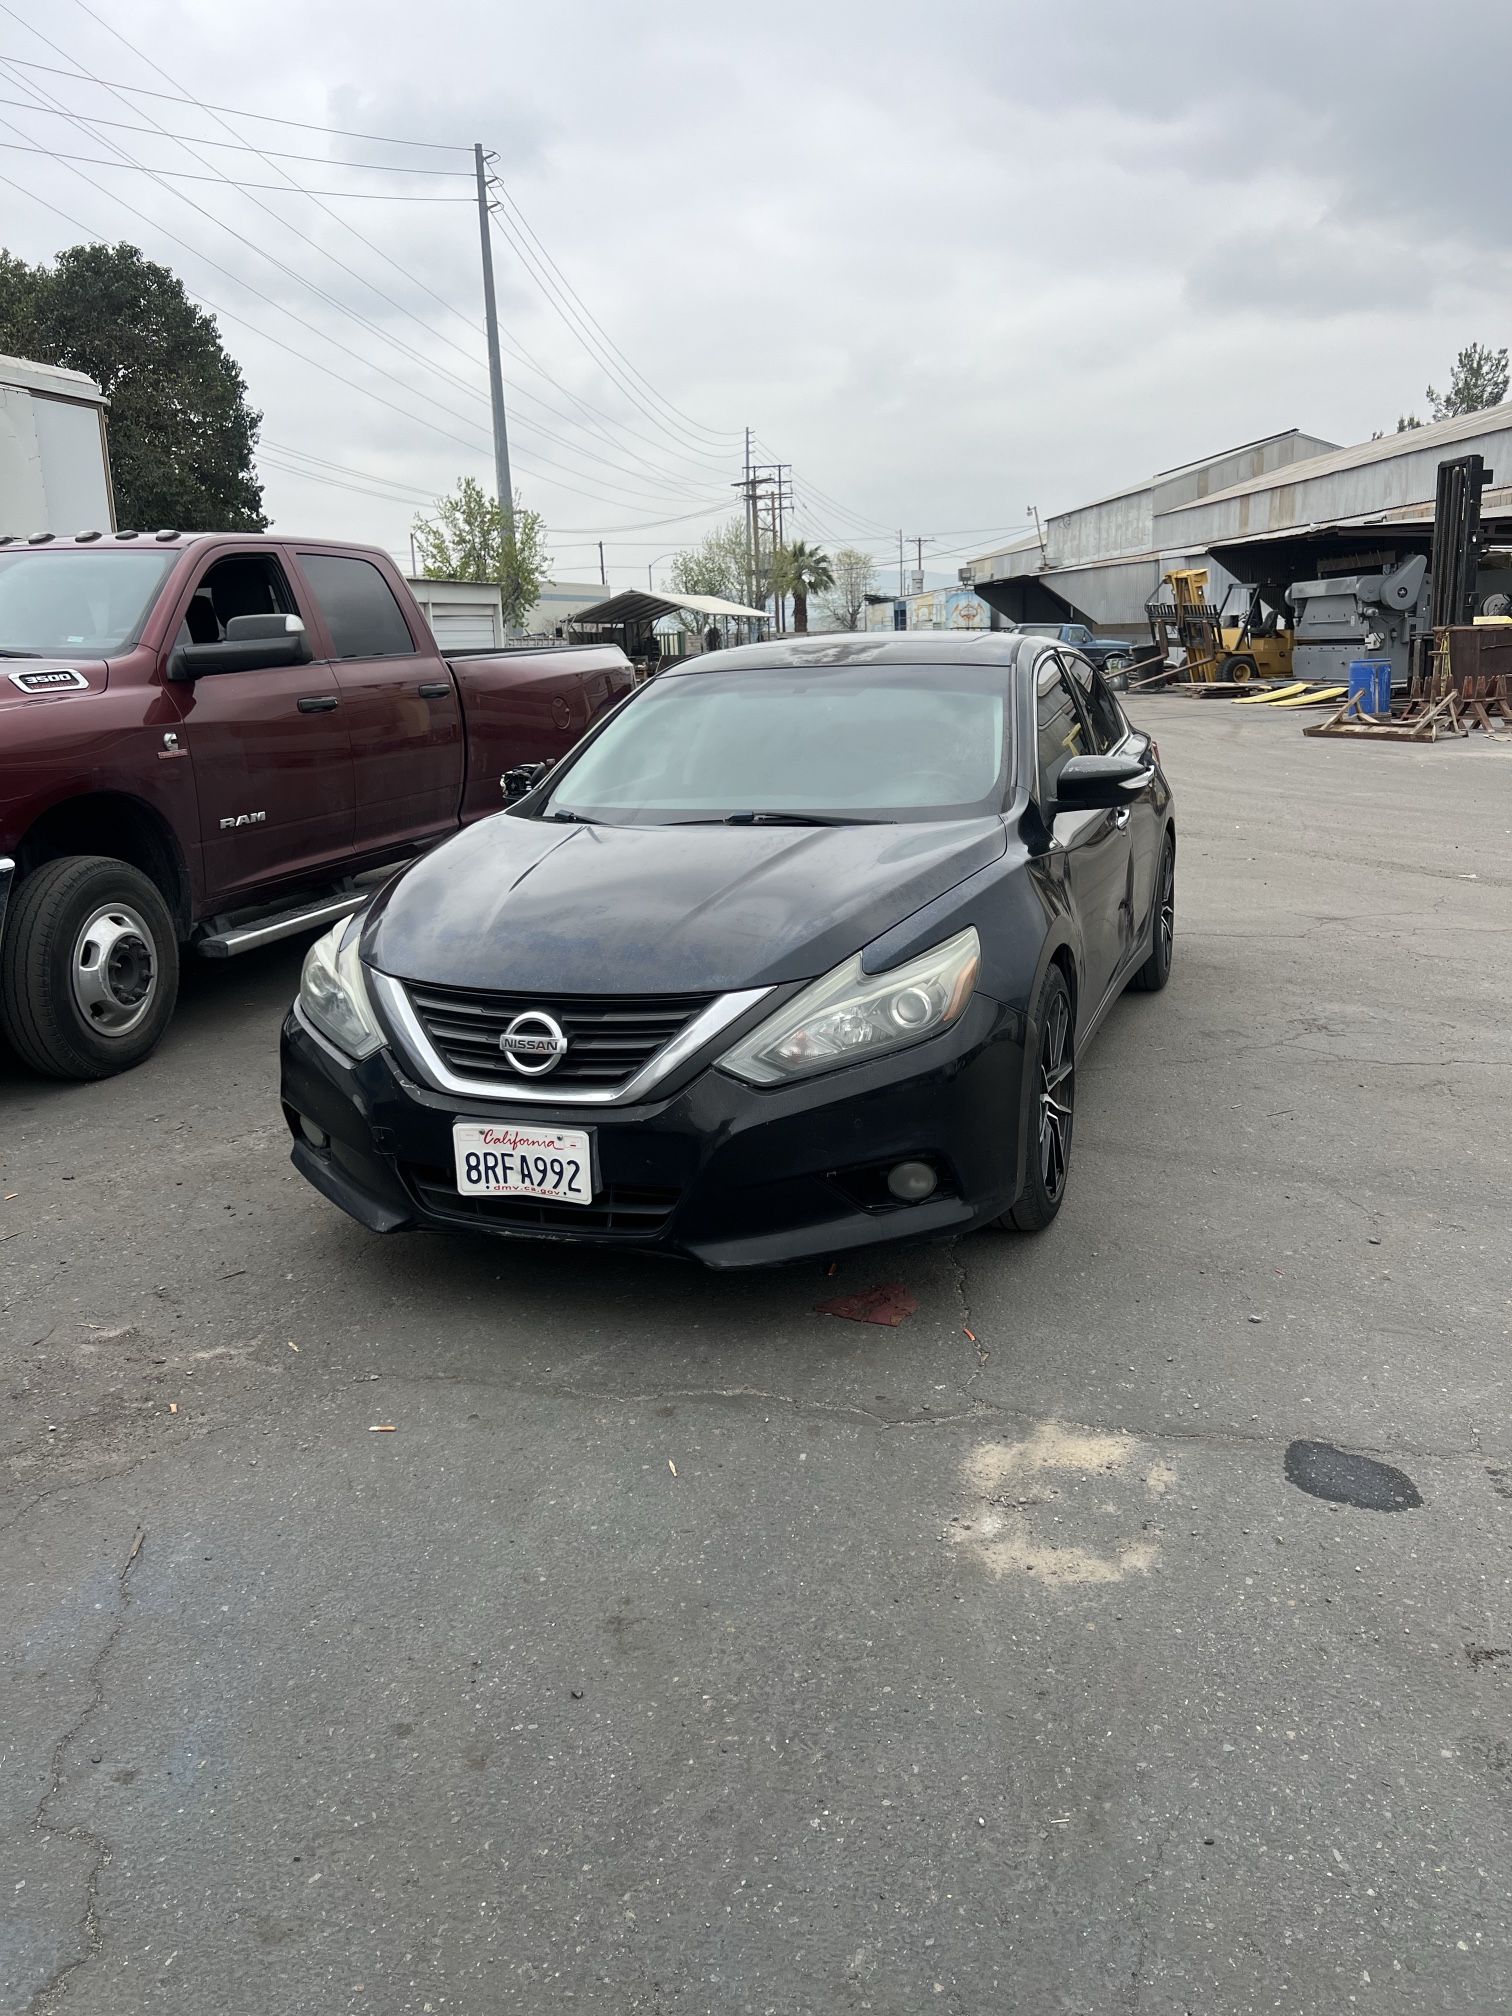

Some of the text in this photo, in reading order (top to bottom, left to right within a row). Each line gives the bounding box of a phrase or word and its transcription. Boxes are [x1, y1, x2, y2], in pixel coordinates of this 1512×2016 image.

[25, 673, 72, 684] 3500
[219, 811, 266, 830] RAM
[504, 1037, 558, 1052] NISSAN
[483, 1128, 565, 1151] California
[465, 1151, 582, 1194] 8RFA992
[493, 1183, 560, 1196] dmv.ca.gov
